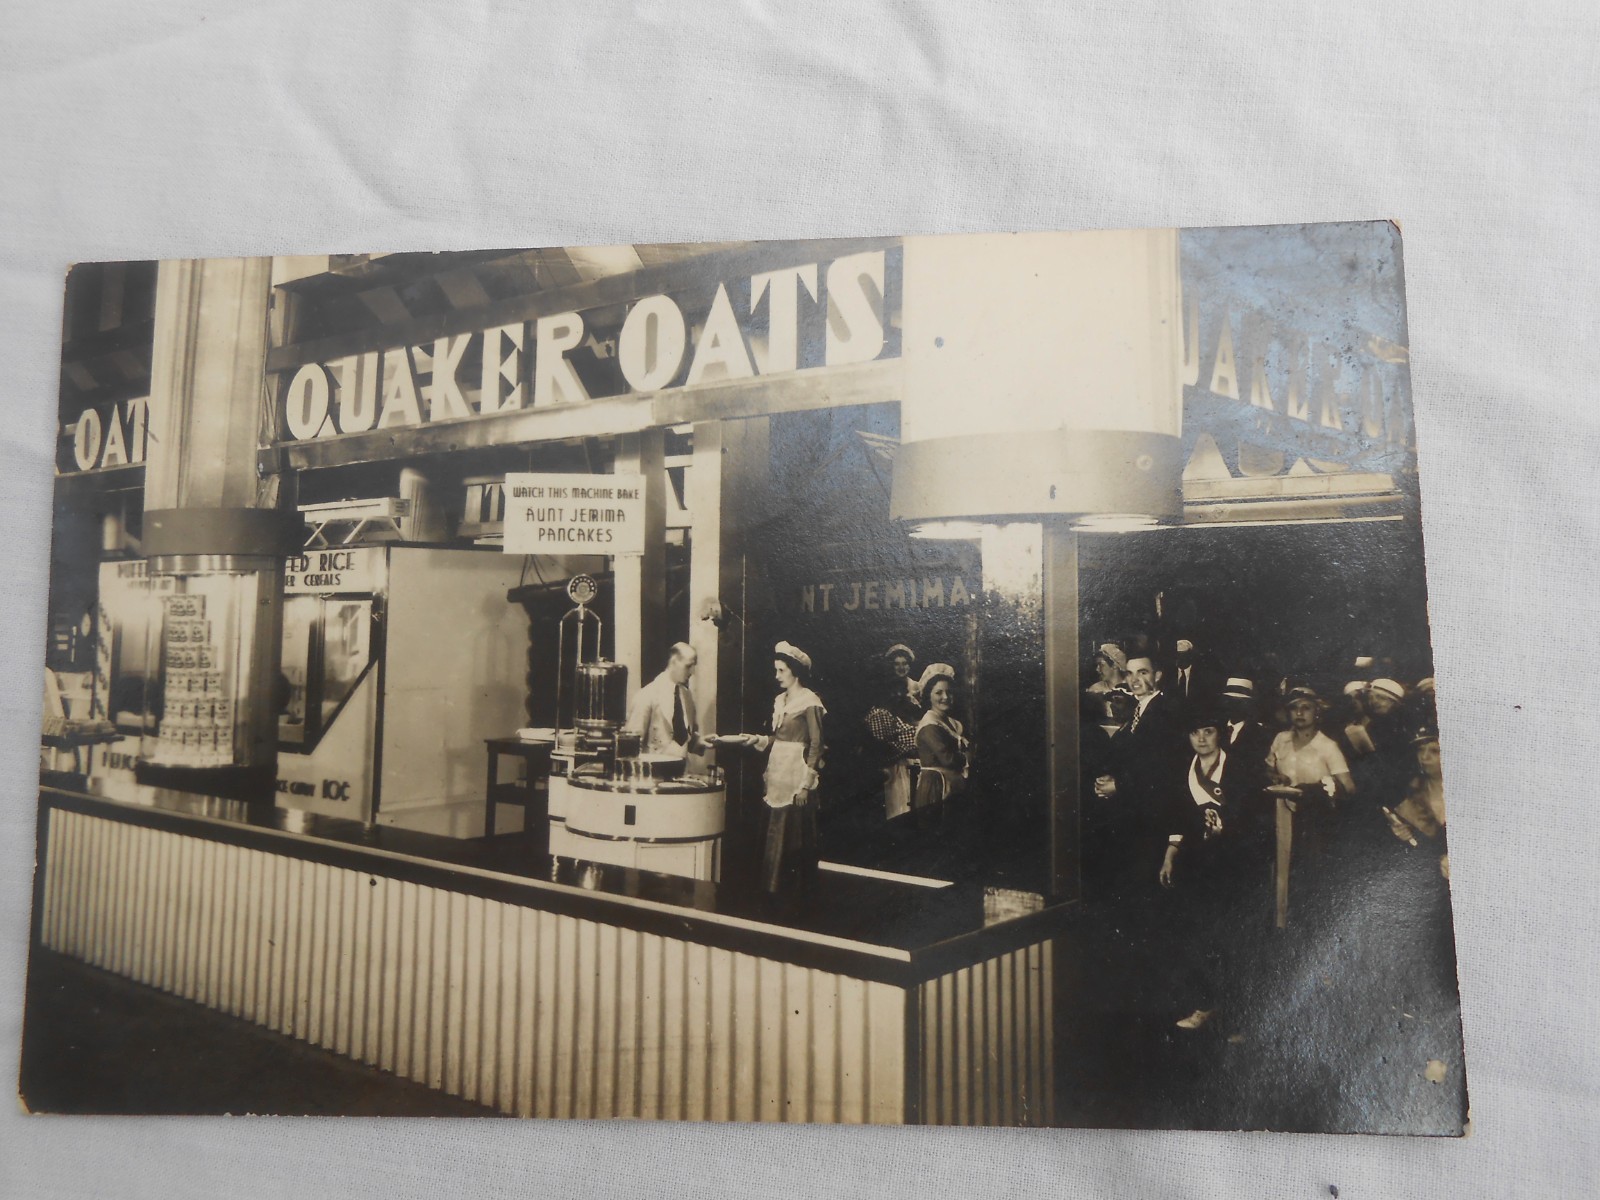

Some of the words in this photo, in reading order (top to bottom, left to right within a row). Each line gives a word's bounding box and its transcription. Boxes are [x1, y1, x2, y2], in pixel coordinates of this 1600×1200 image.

[285, 311, 590, 440] QUAKER
[618, 250, 886, 392] OATS
[513, 487, 544, 499] WATCH
[548, 487, 568, 499] THIS
[572, 487, 613, 500] MACHINE
[617, 488, 640, 500] BAKE
[526, 507, 563, 522] AUNT
[538, 527, 613, 542] PANCAKES
[320, 551, 356, 571] RICE
[304, 573, 341, 587] CEREALS
[843, 575, 970, 611] JEMIMA
